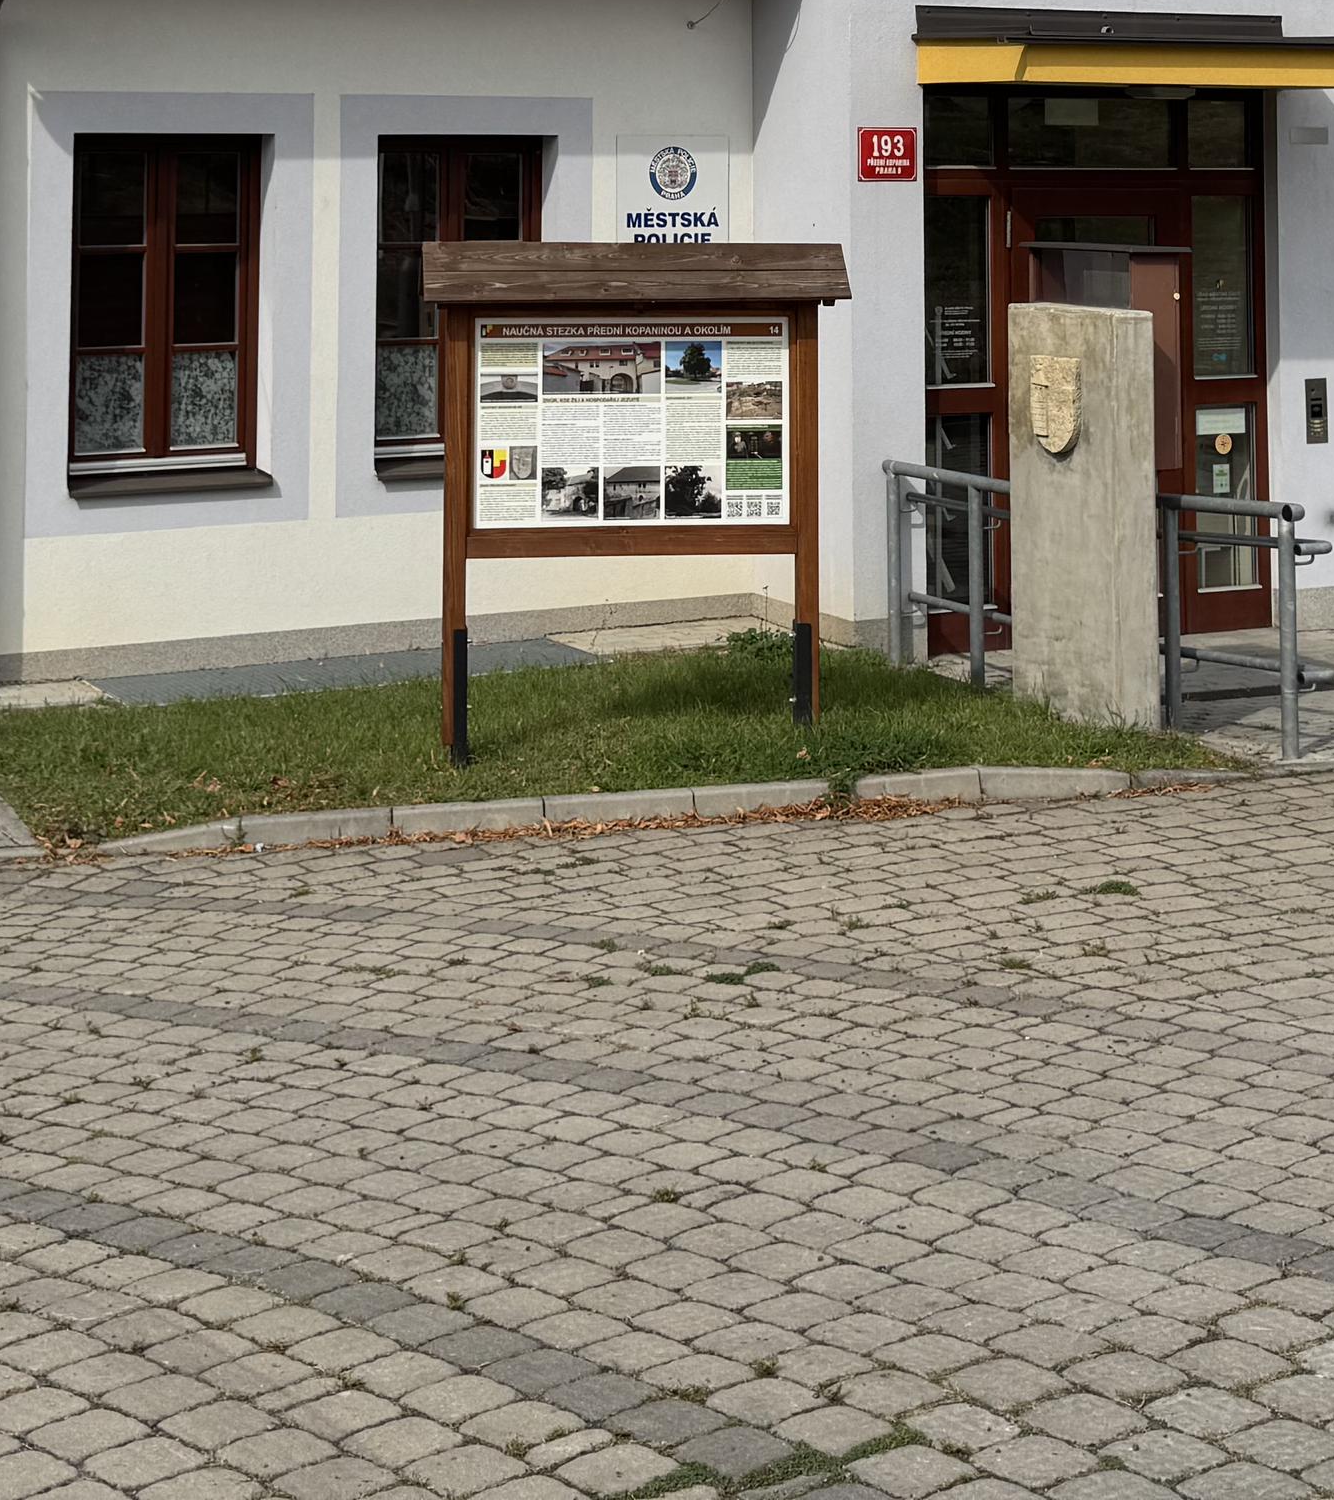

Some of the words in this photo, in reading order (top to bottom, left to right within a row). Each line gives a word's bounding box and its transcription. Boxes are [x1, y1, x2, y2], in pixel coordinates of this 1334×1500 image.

[872, 134, 904, 157] 193
[626, 206, 719, 228] MĚSTSKÁ
[502, 324, 544, 336] NAUČNÁ
[546, 326, 585, 336] STEZKA
[587, 324, 623, 335] PŘEDNÍ
[625, 326, 682, 335] KOPANINOU
[684, 326, 692, 335] A
[693, 324, 731, 335] OKOLÍM
[769, 326, 779, 334] 14
